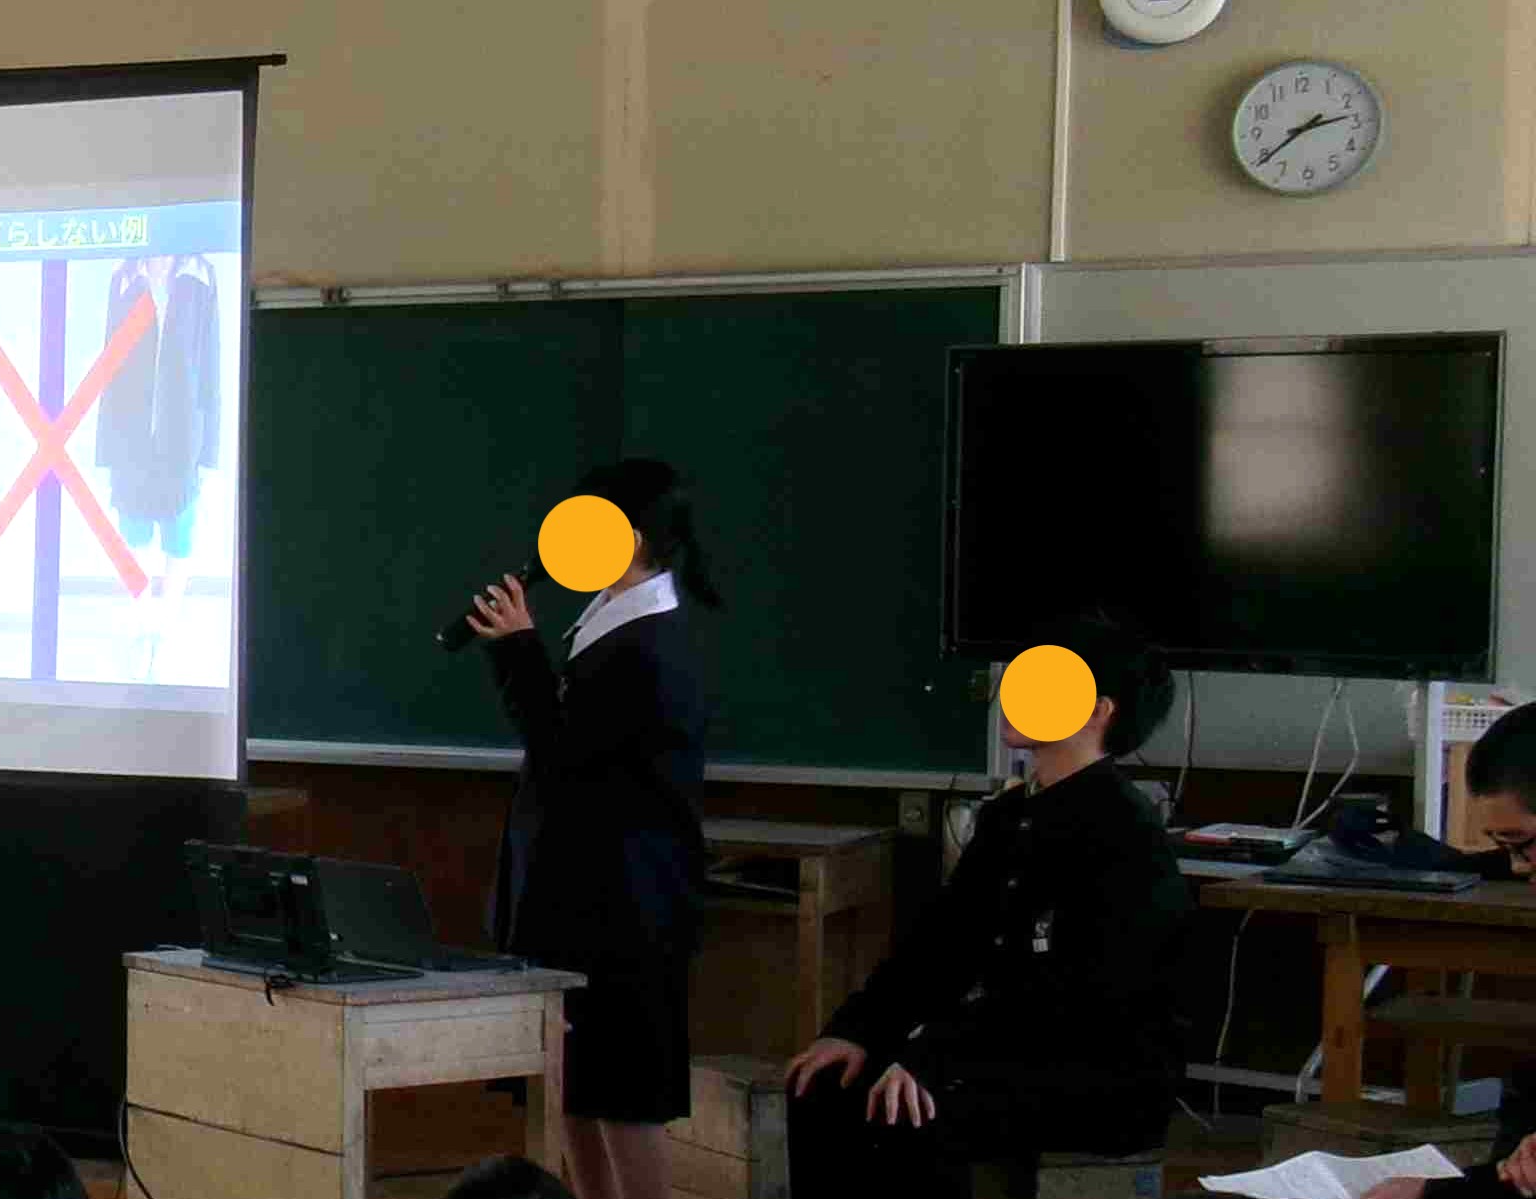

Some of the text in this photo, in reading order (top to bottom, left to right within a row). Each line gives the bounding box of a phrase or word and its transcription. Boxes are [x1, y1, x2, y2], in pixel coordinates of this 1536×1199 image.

[1272, 85, 1284, 102] 11
[1294, 77, 1310, 94] 12
[1324, 79, 1331, 94] 1
[1342, 93, 1352, 109] 2
[1254, 103, 1269, 121] 10
[1350, 113, 1361, 130] 3
[1250, 126, 1263, 142] 9
[1345, 137, 1356, 151] 4
[1278, 160, 1288, 176] 7
[1328, 154, 1339, 172] 5
[1302, 167, 1315, 181] 6
